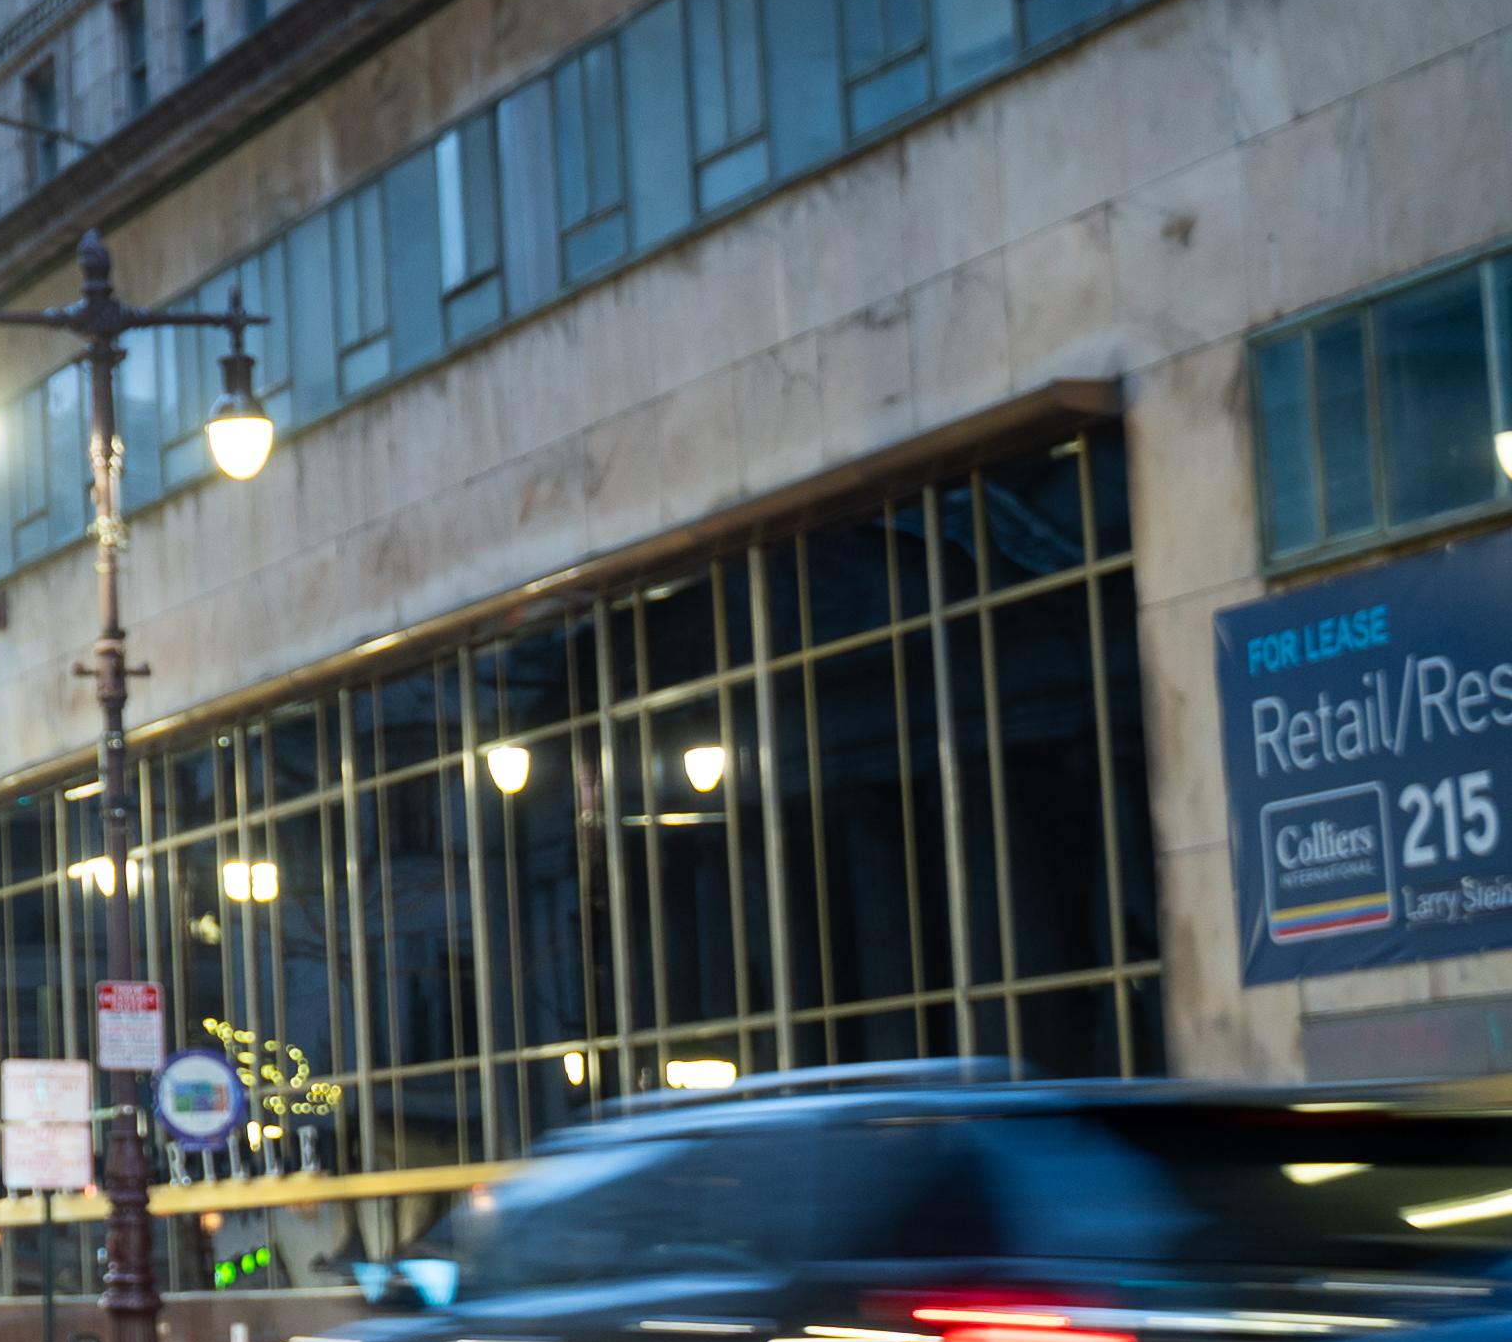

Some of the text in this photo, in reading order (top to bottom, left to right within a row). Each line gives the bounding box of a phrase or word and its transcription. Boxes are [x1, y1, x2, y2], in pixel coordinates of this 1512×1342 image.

[1248, 606, 1390, 677] FOR LEASE
[1276, 820, 1376, 870] Colliers
[1398, 769, 1500, 868] 215
